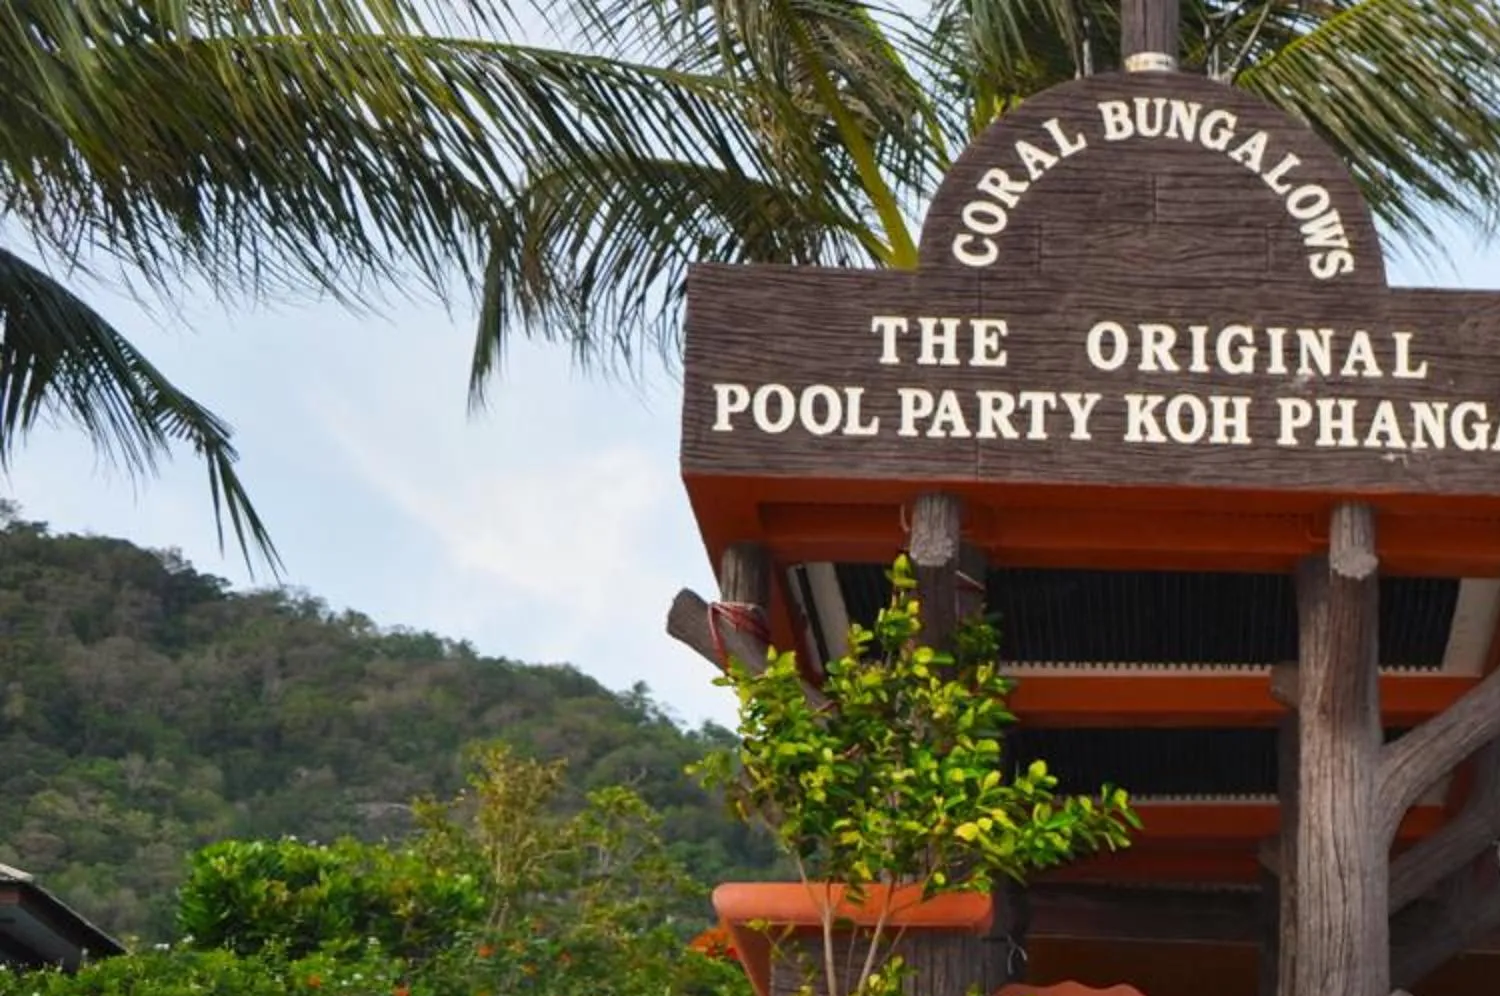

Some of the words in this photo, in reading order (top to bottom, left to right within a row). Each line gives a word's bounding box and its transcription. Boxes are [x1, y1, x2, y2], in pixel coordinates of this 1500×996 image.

[953, 117, 1085, 268] CORAL
[1098, 97, 1353, 280] BUNGALOWS
[872, 318, 1008, 366] THE
[1086, 321, 1428, 378] ORIGINAL
[712, 385, 878, 434] POOL
[899, 391, 1103, 441] PARTY
[1125, 395, 1250, 445] KOH
